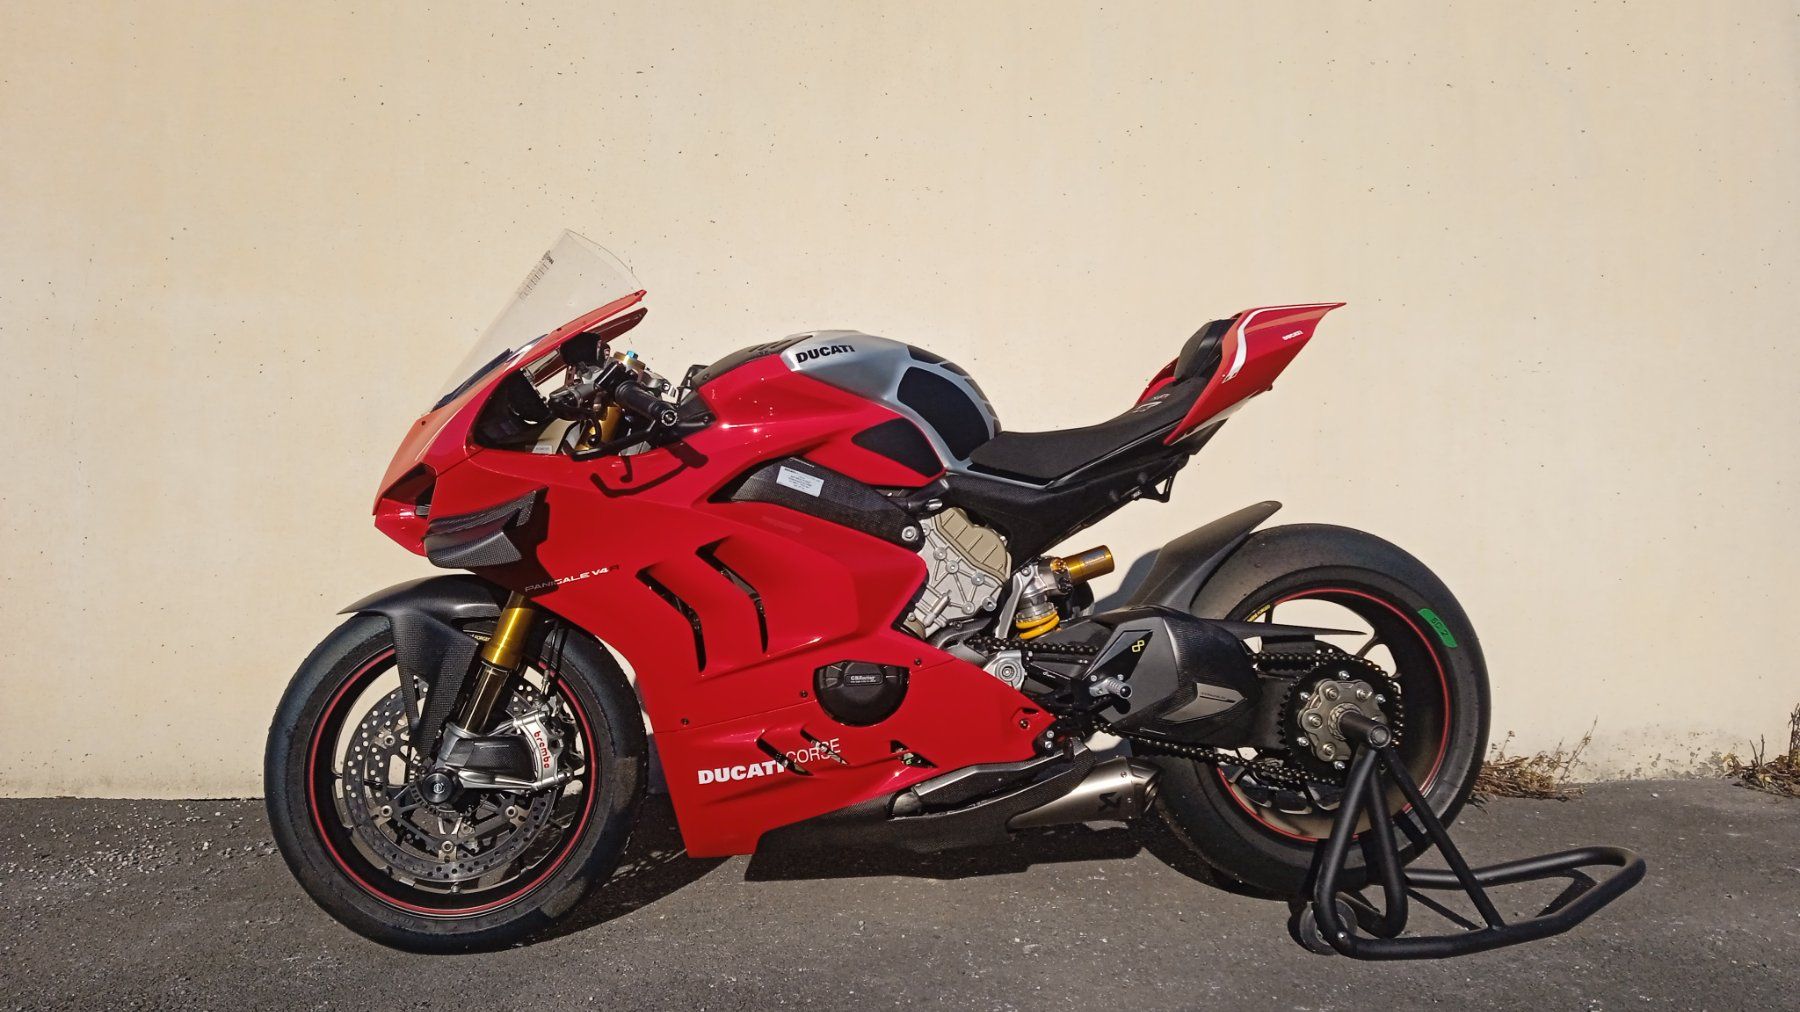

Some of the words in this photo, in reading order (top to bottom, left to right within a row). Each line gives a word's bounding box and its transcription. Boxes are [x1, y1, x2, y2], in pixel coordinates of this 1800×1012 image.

[795, 344, 856, 363] DUCATI
[533, 730, 551, 769] brembo
[697, 759, 785, 785] DUCATI
